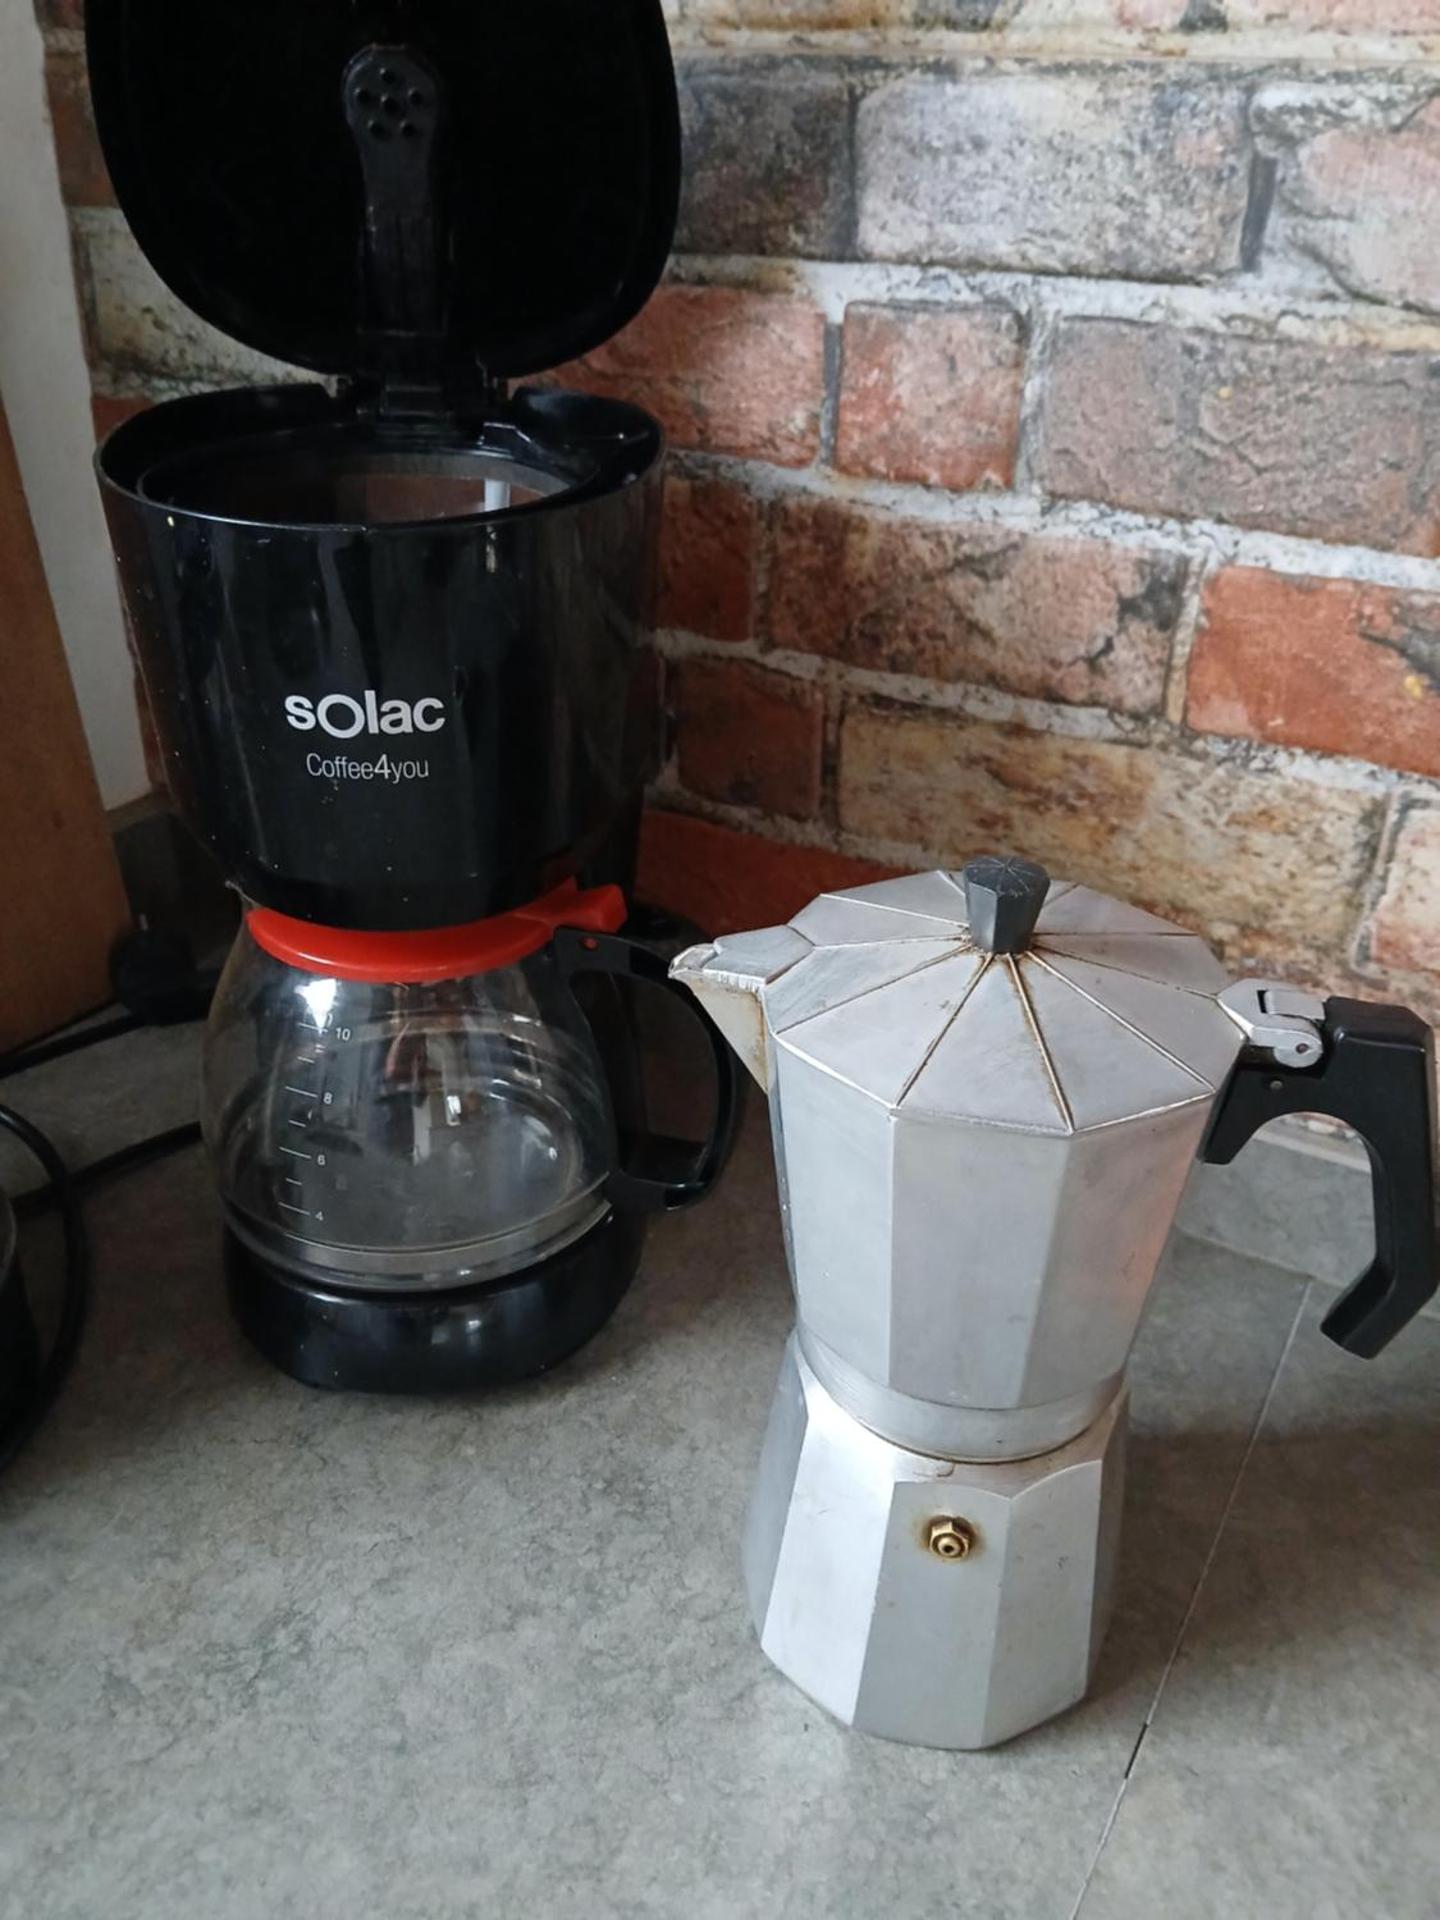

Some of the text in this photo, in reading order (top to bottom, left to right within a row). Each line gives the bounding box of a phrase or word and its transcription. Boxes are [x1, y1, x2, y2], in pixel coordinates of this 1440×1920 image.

[306, 752, 430, 784] Coffee4you
[335, 1027, 351, 1041] 10
[323, 1092, 333, 1104] 8
[317, 1154, 326, 1166] 6
[315, 1211, 325, 1222] 4
